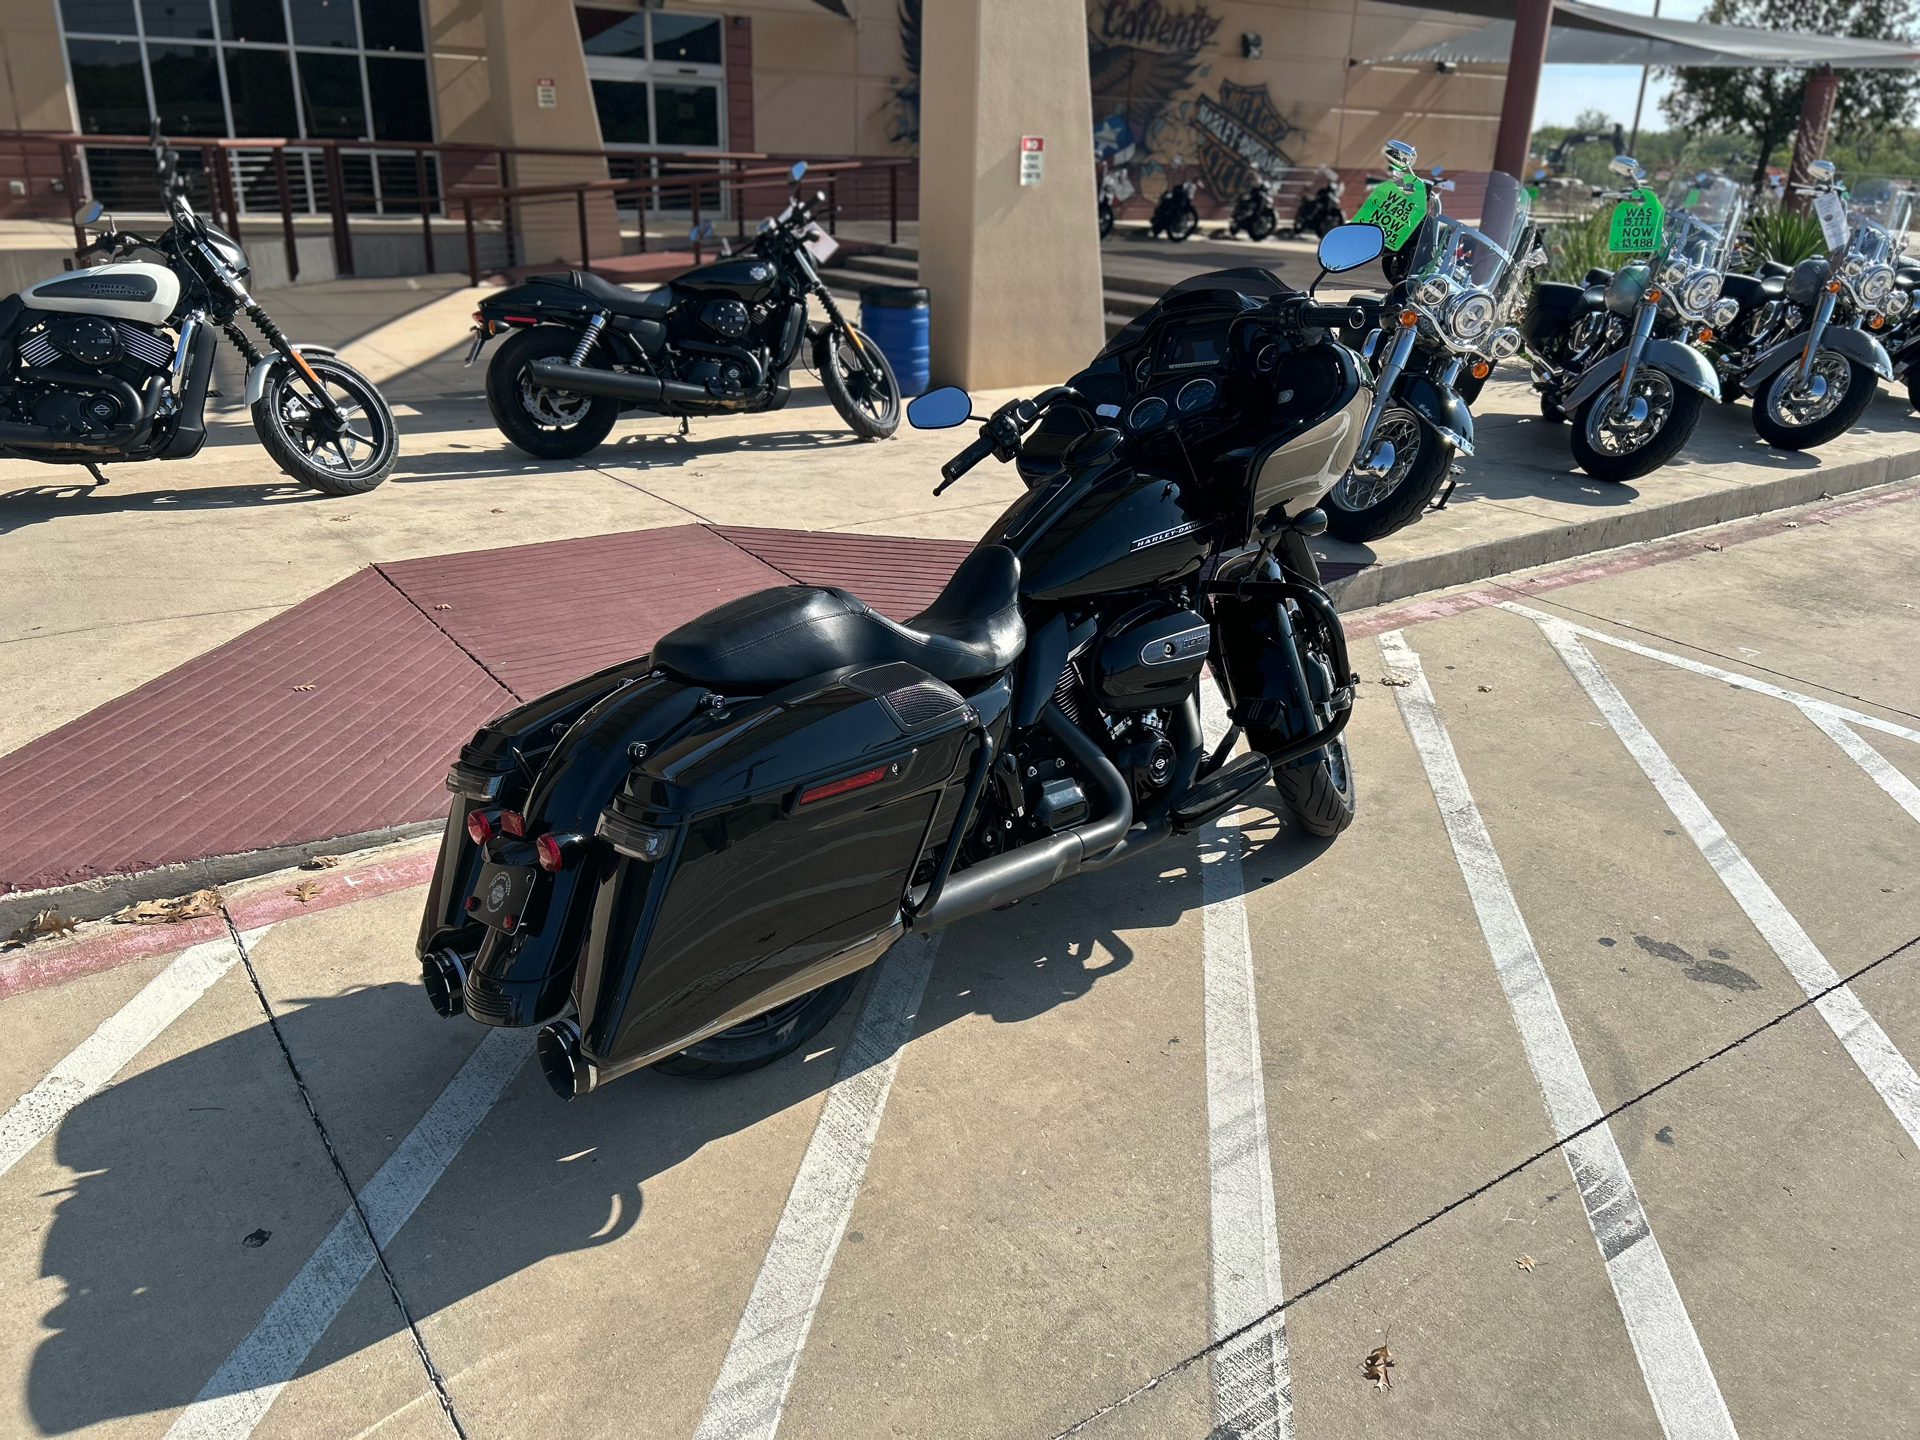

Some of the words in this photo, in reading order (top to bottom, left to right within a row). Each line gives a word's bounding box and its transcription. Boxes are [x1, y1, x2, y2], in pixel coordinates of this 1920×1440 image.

[1386, 190, 1415, 212] WAS
[1626, 207, 1653, 217] WAS
[1370, 209, 1405, 232] NOW
[1622, 227, 1653, 237] NOW
[88, 282, 128, 290] HARLEY
[95, 288, 147, 296] DAVIDSON
